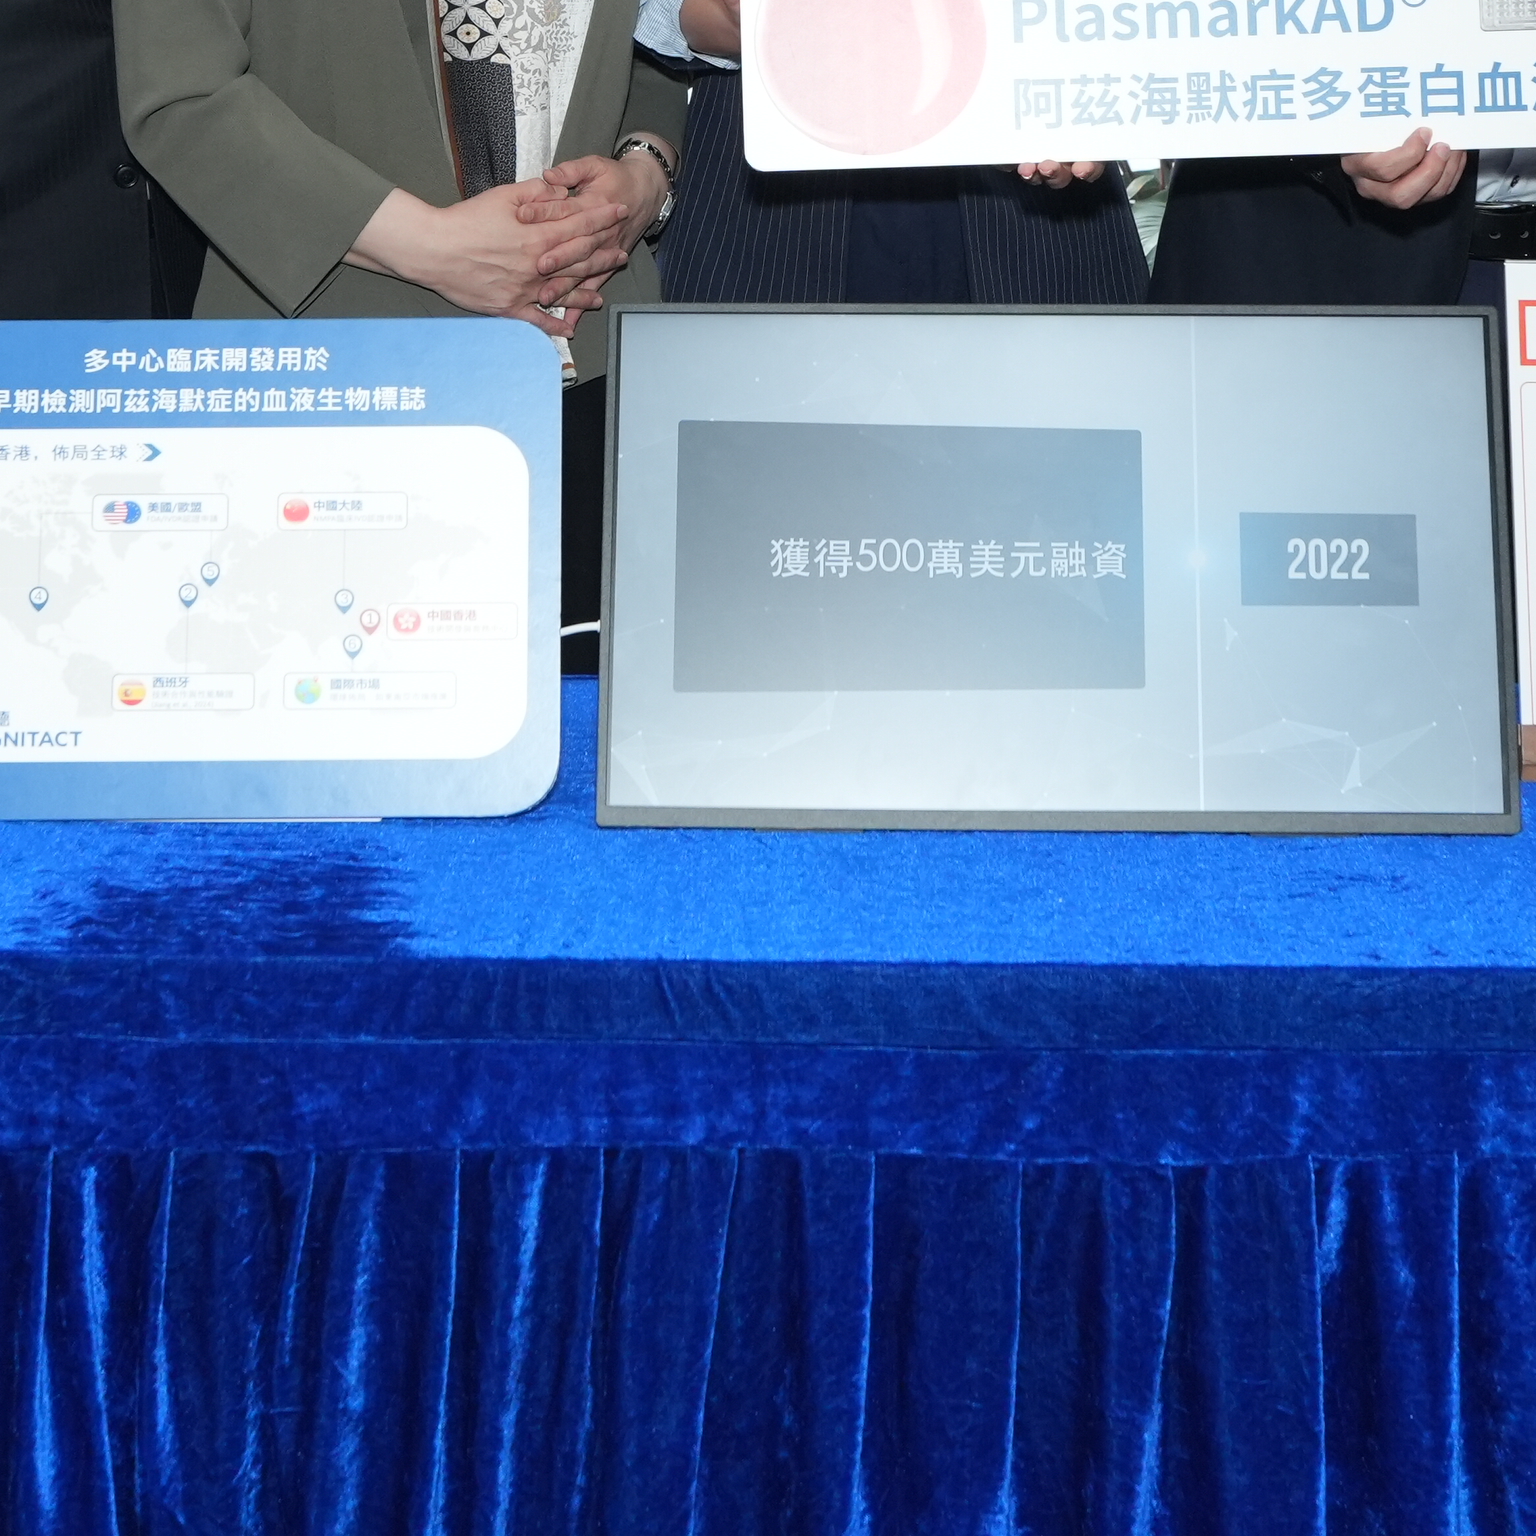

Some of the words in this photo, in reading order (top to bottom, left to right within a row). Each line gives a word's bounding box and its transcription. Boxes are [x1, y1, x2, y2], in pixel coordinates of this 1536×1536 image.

[83, 345, 330, 374] 多中心臨床開發用於
[314, 500, 363, 512] 中國大陸
[769, 536, 1129, 583] 獲得500萬美元融資
[1287, 537, 1371, 582] 2022
[205, 565, 216, 578] 5
[33, 590, 45, 602] 4
[183, 587, 194, 601] 2
[340, 593, 349, 604] 3
[366, 613, 374, 625] 1
[427, 609, 477, 622] 中國香港
[348, 638, 357, 650] 6
[152, 676, 190, 689] 西班牙
[330, 678, 380, 690] 國際市場
